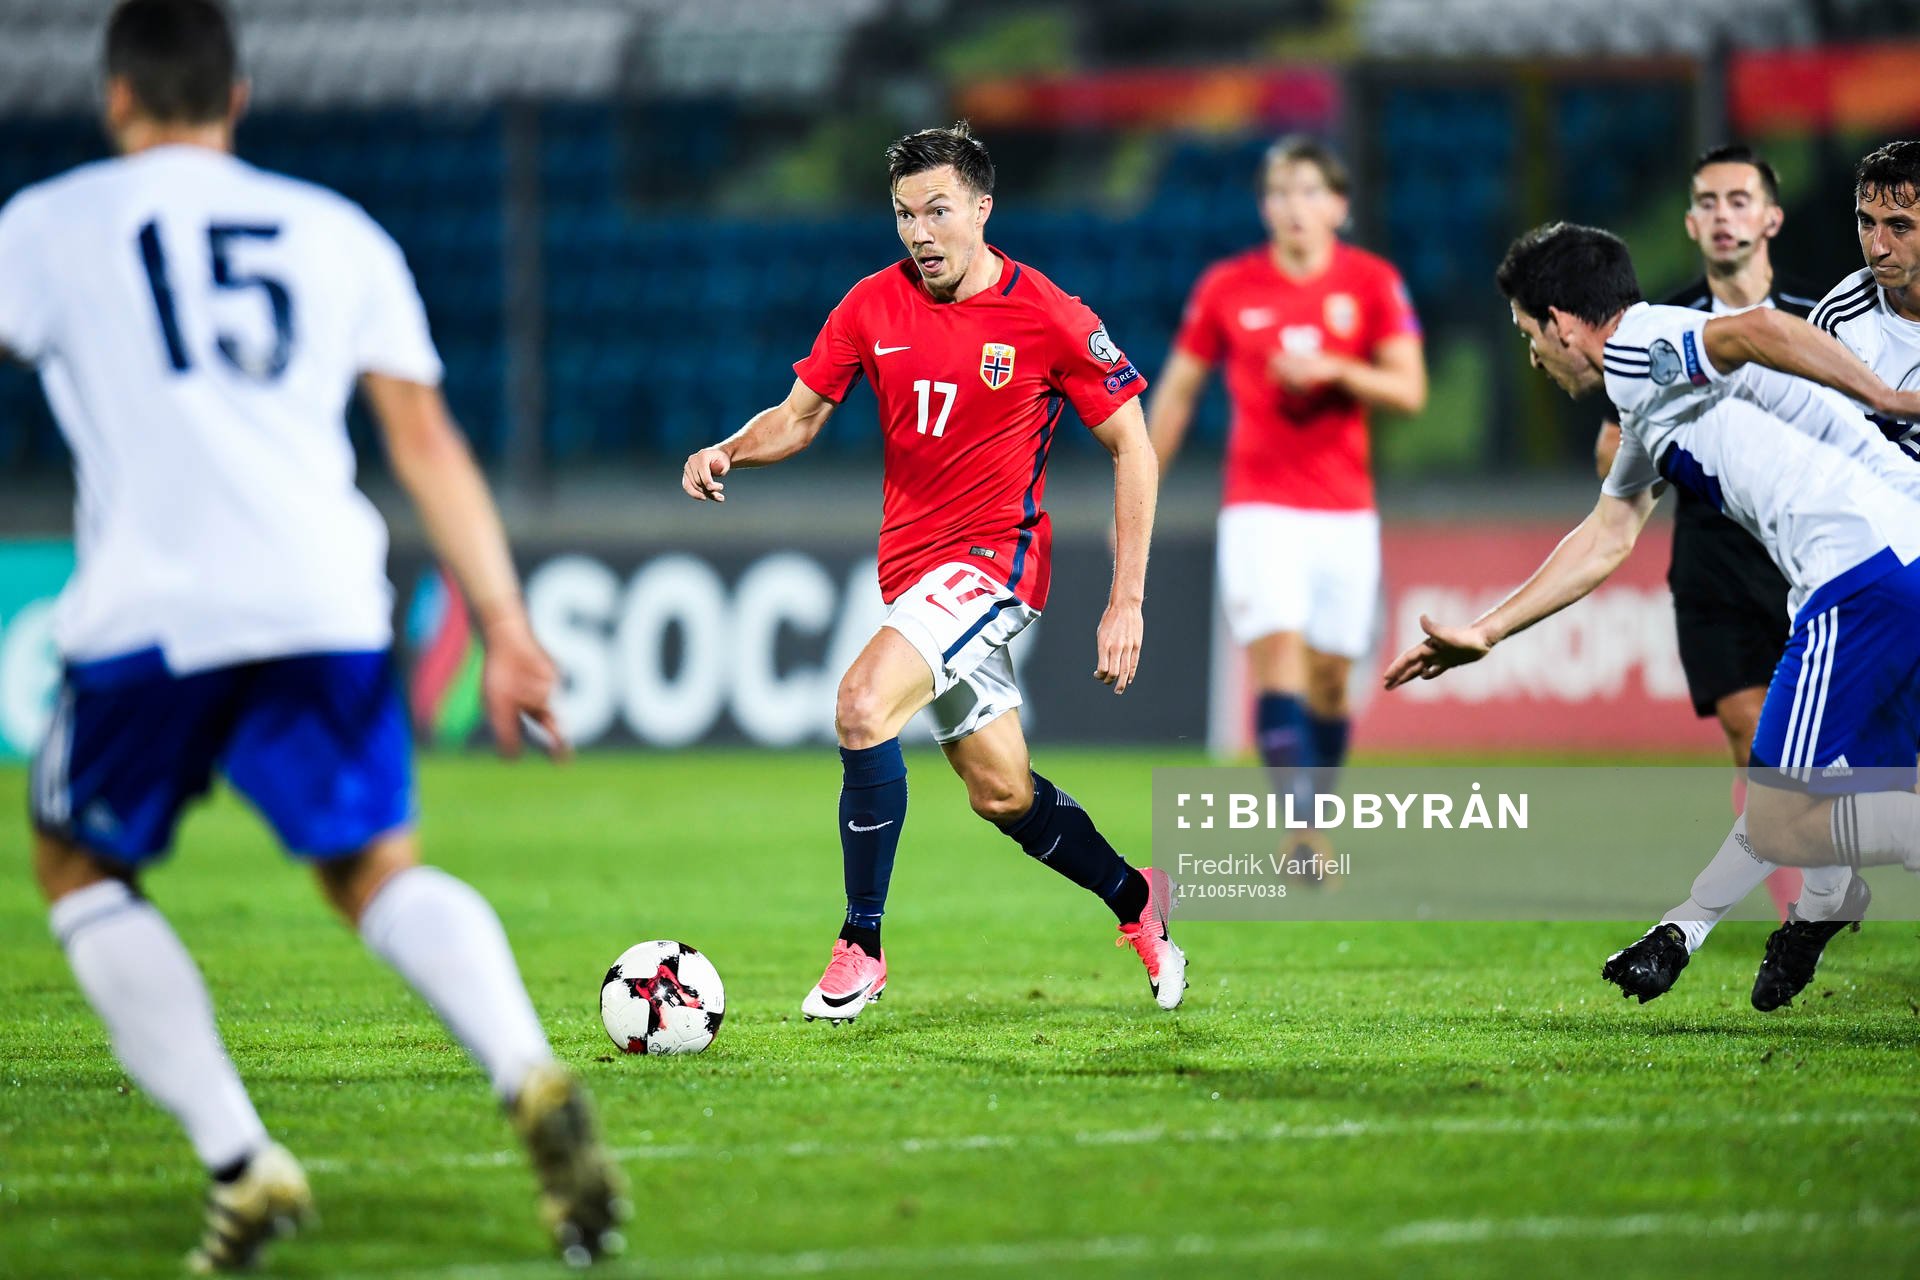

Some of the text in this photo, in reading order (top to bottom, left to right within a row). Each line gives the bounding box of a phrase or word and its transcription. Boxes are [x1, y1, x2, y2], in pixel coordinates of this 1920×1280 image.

[138, 221, 293, 378] 15
[913, 379, 958, 438] 17
[527, 551, 1038, 748] SOCA
